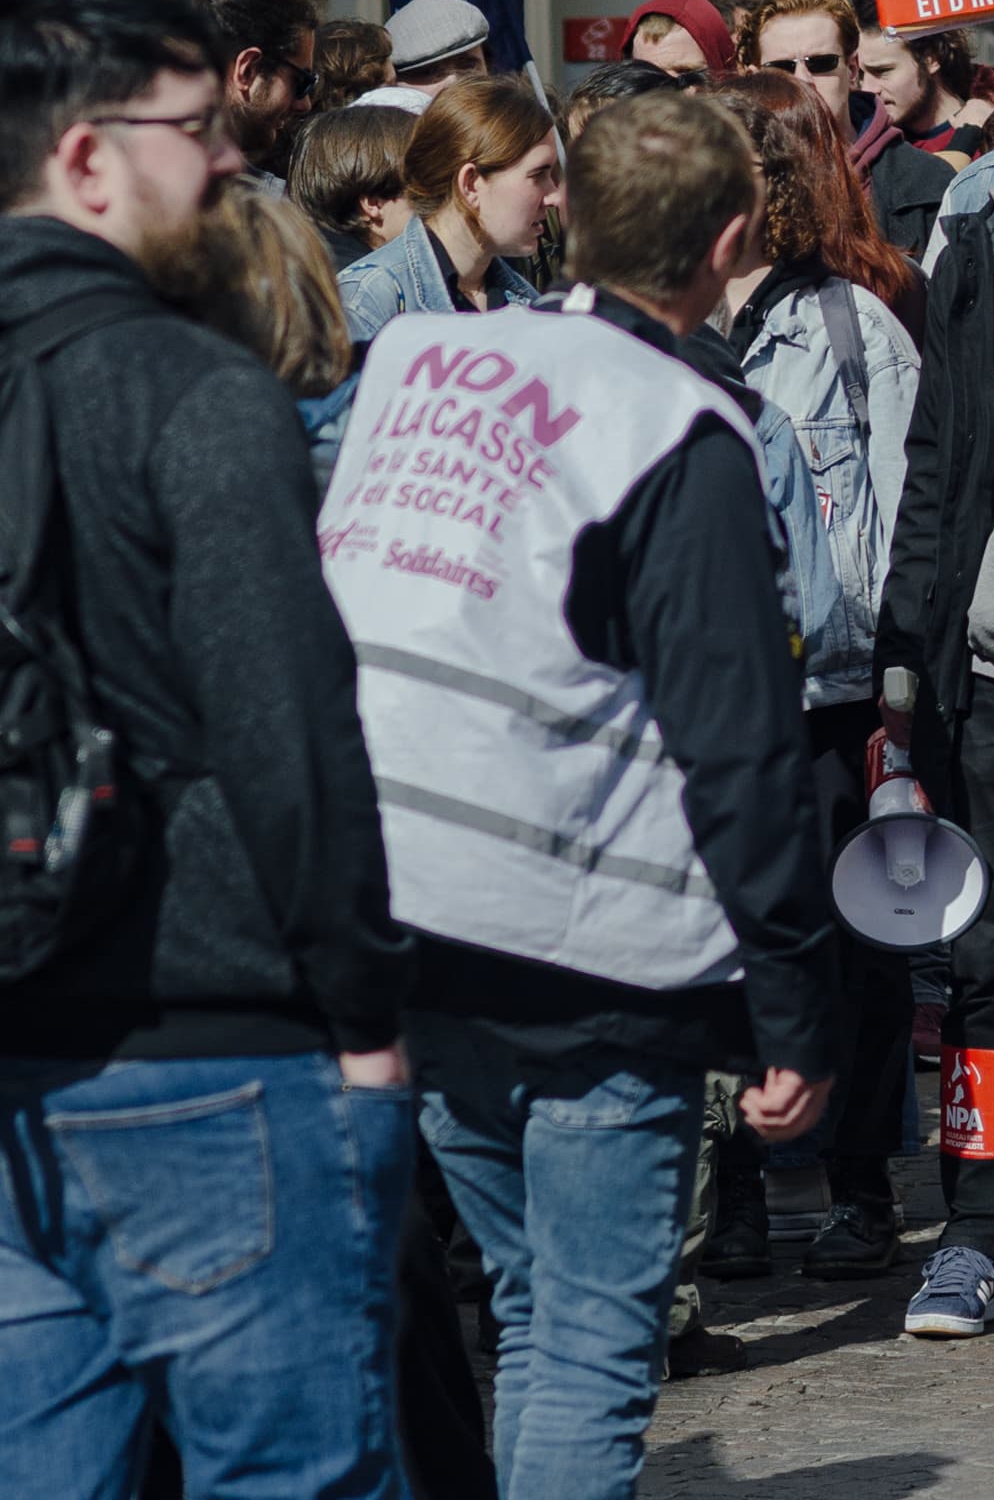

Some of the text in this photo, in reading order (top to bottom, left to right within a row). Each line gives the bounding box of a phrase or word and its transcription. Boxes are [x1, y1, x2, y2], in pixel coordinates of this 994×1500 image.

[404, 345, 583, 447] NON
[431, 398, 557, 490] CASSE
[393, 482, 503, 543] SOCIAL
[946, 1104, 984, 1132] NPA
